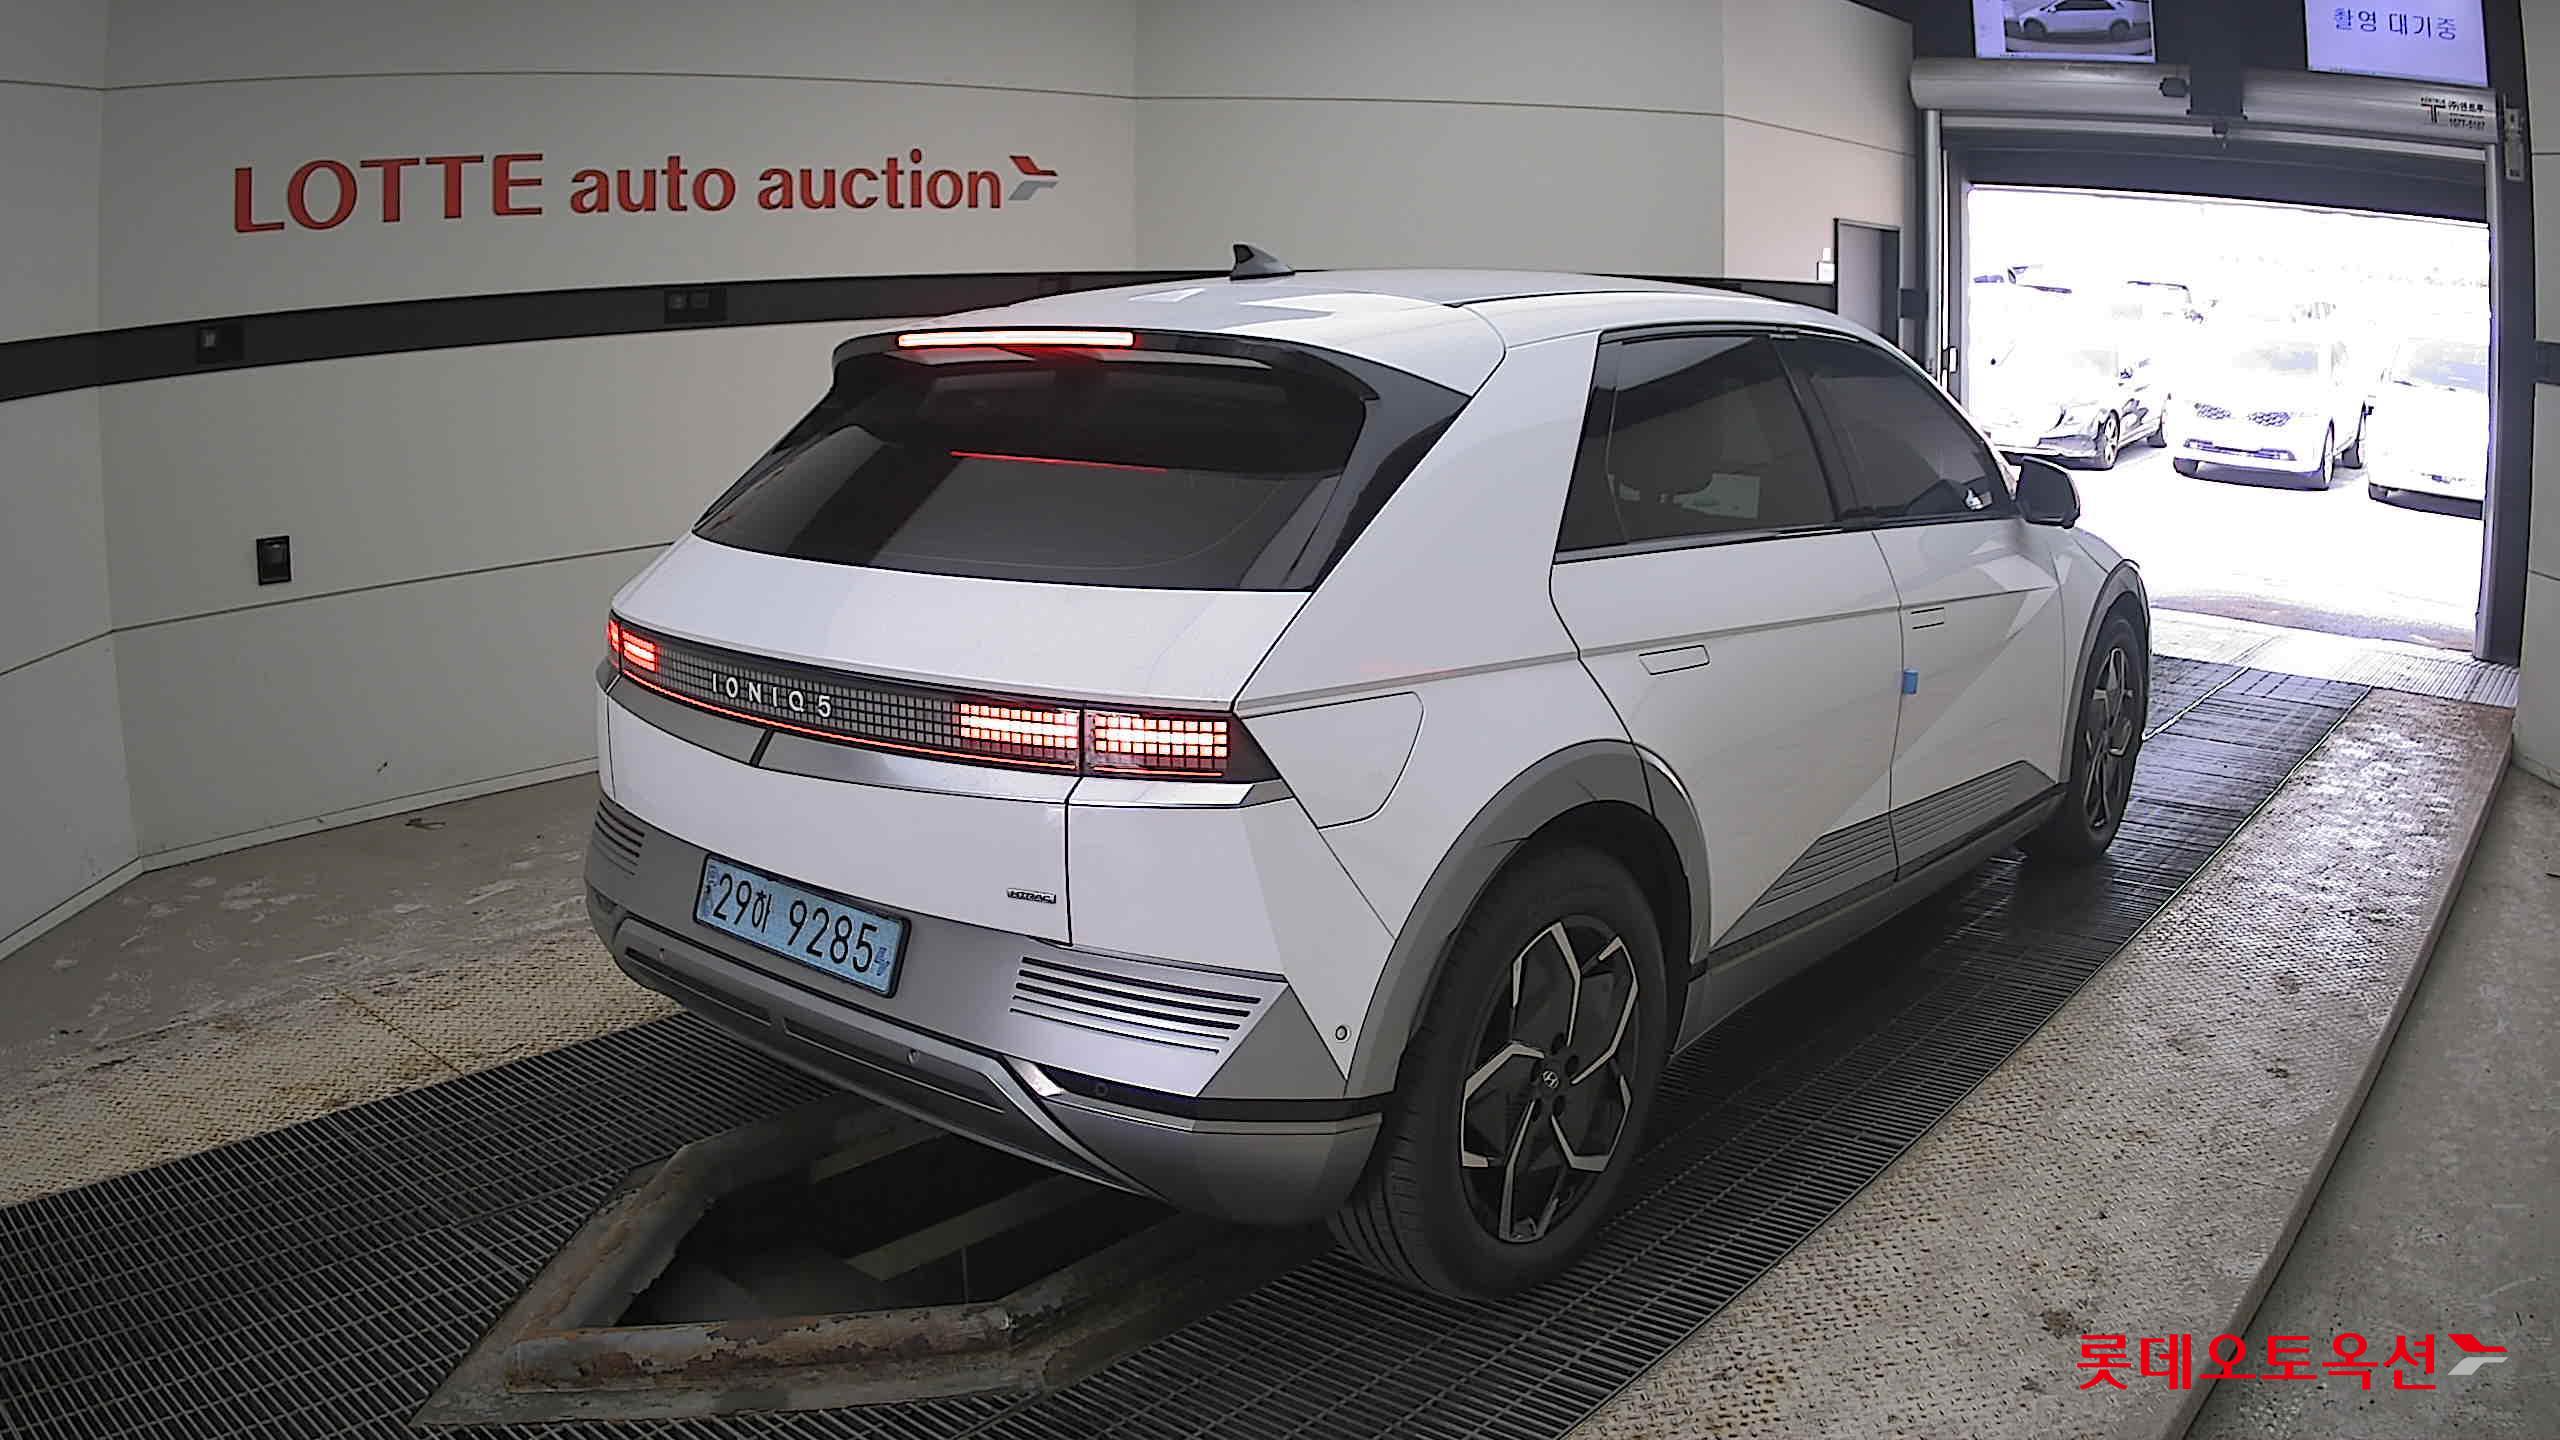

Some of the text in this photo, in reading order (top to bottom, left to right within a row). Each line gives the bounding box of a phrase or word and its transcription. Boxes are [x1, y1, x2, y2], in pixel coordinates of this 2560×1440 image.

[2389, 13, 2457, 40] 대기중
[234, 148, 1003, 233] LOTTE auto auction
[712, 673, 832, 718] IONIQ 5
[713, 873, 879, 973] 29하 9285
